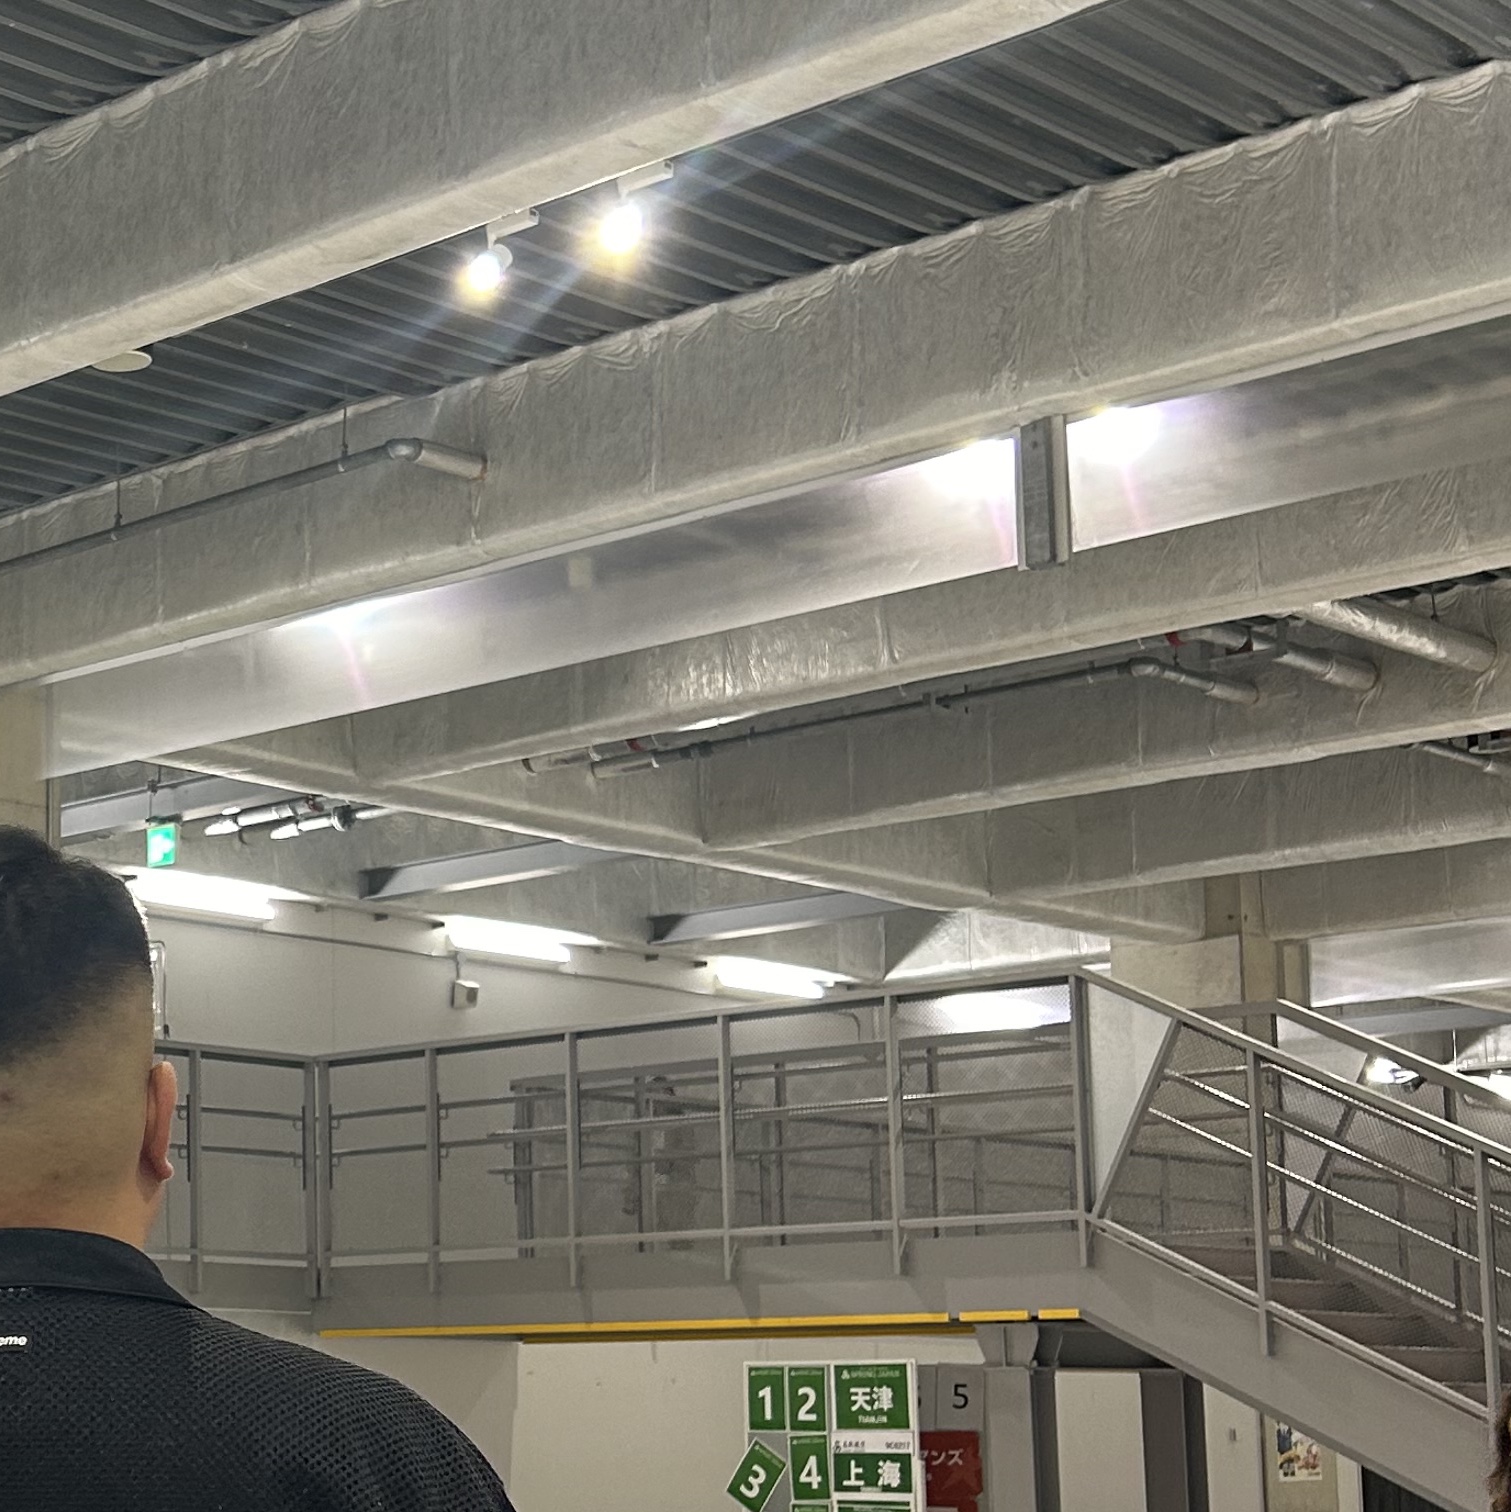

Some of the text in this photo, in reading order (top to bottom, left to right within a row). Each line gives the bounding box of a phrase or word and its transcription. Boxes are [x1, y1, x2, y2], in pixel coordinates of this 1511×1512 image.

[758, 1385, 773, 1421] 1
[797, 1386, 818, 1421] 2
[849, 1385, 894, 1412] 天津
[952, 1383, 969, 1410] 5
[739, 1464, 767, 1499] 3
[798, 1455, 822, 1490] 4
[842, 1459, 901, 1489] 上海
